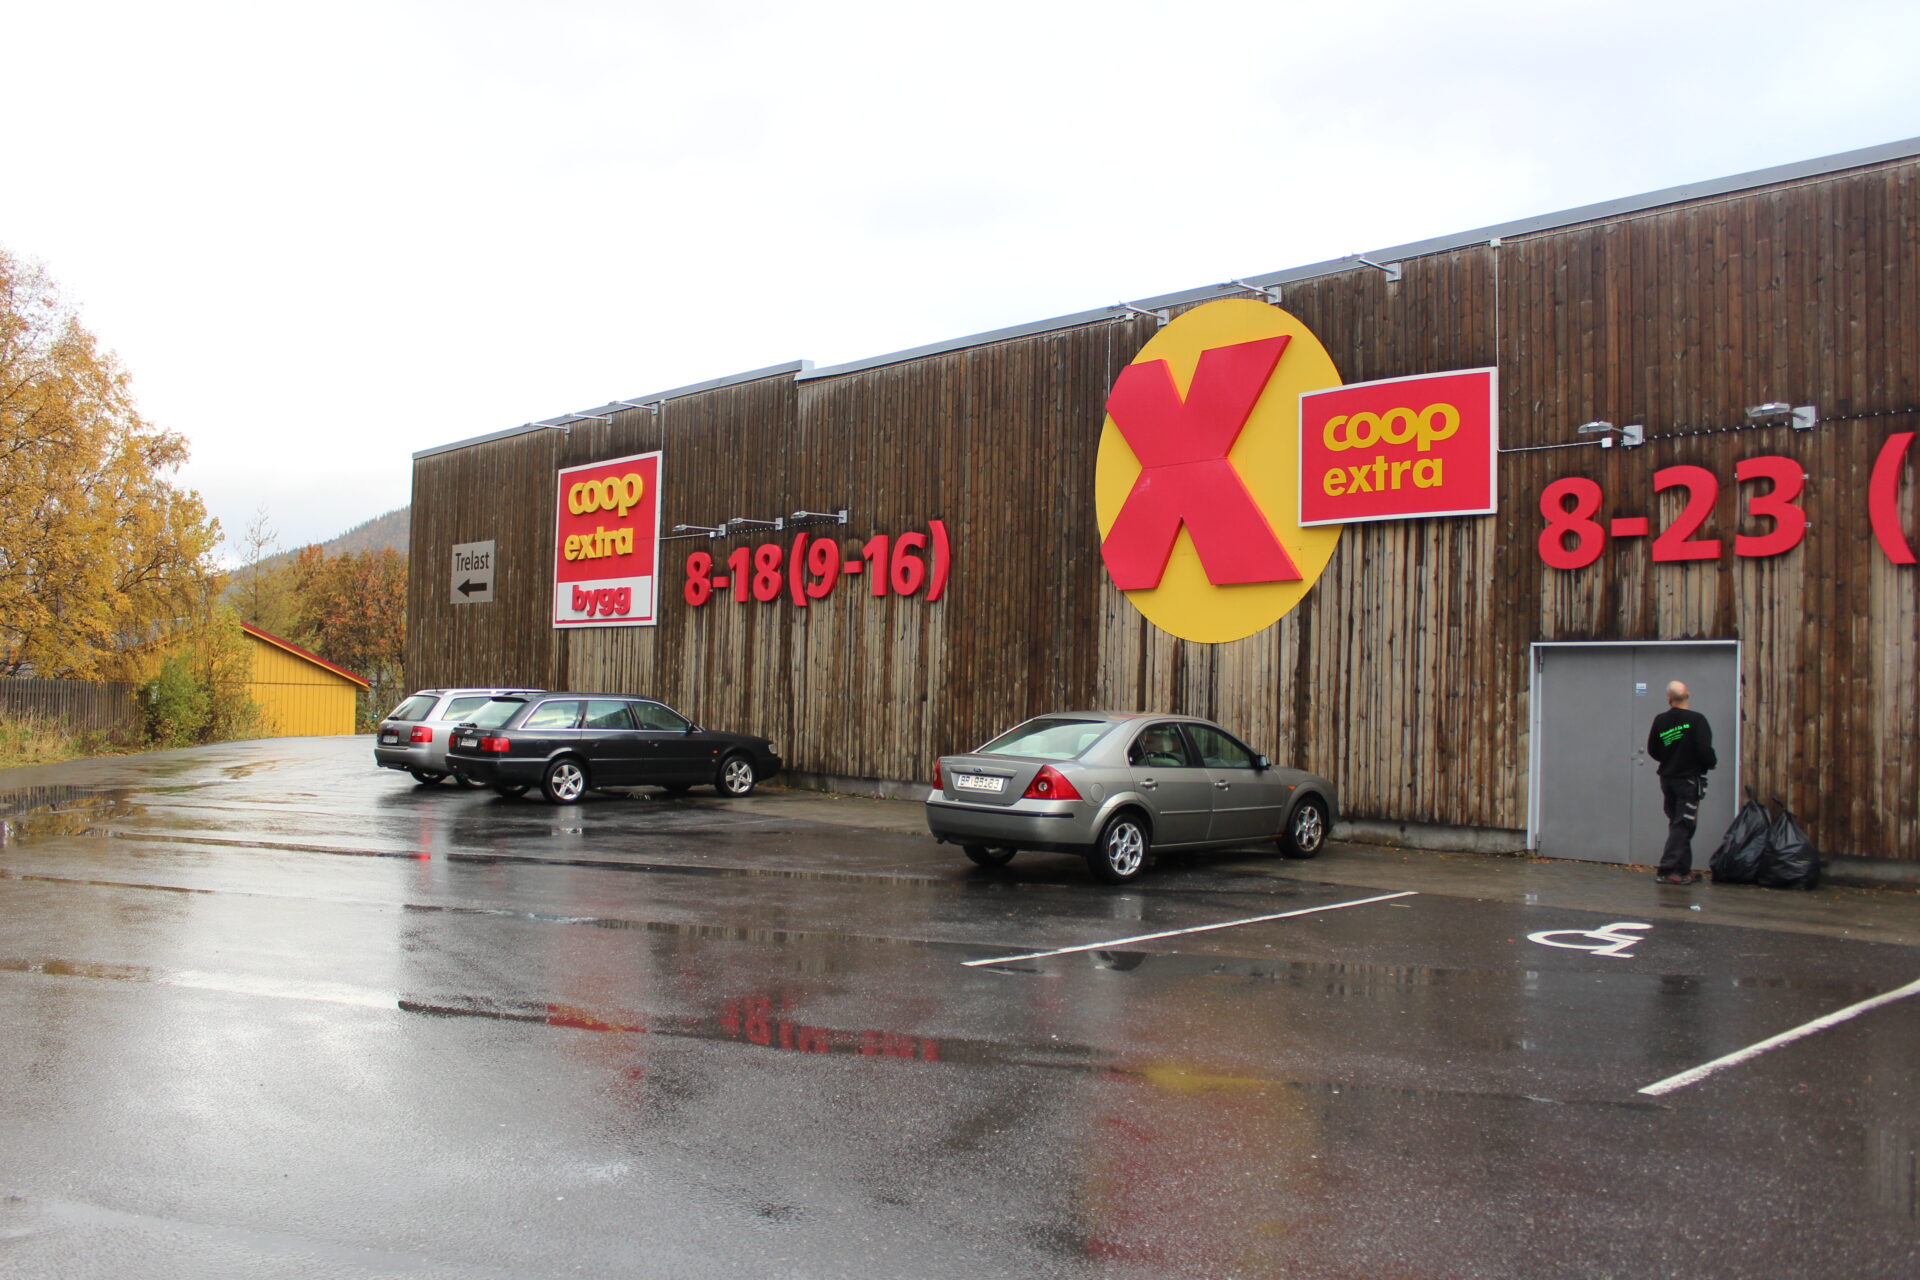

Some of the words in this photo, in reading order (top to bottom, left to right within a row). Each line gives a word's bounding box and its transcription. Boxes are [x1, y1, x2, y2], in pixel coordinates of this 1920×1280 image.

[1323, 403, 1460, 452] coop
[568, 473, 643, 517] coop
[1323, 455, 1443, 497] extra
[1538, 456, 1807, 570] 8-23
[455, 550, 490, 572] Trelast
[564, 526, 634, 561] extra
[571, 585, 632, 616] bygg
